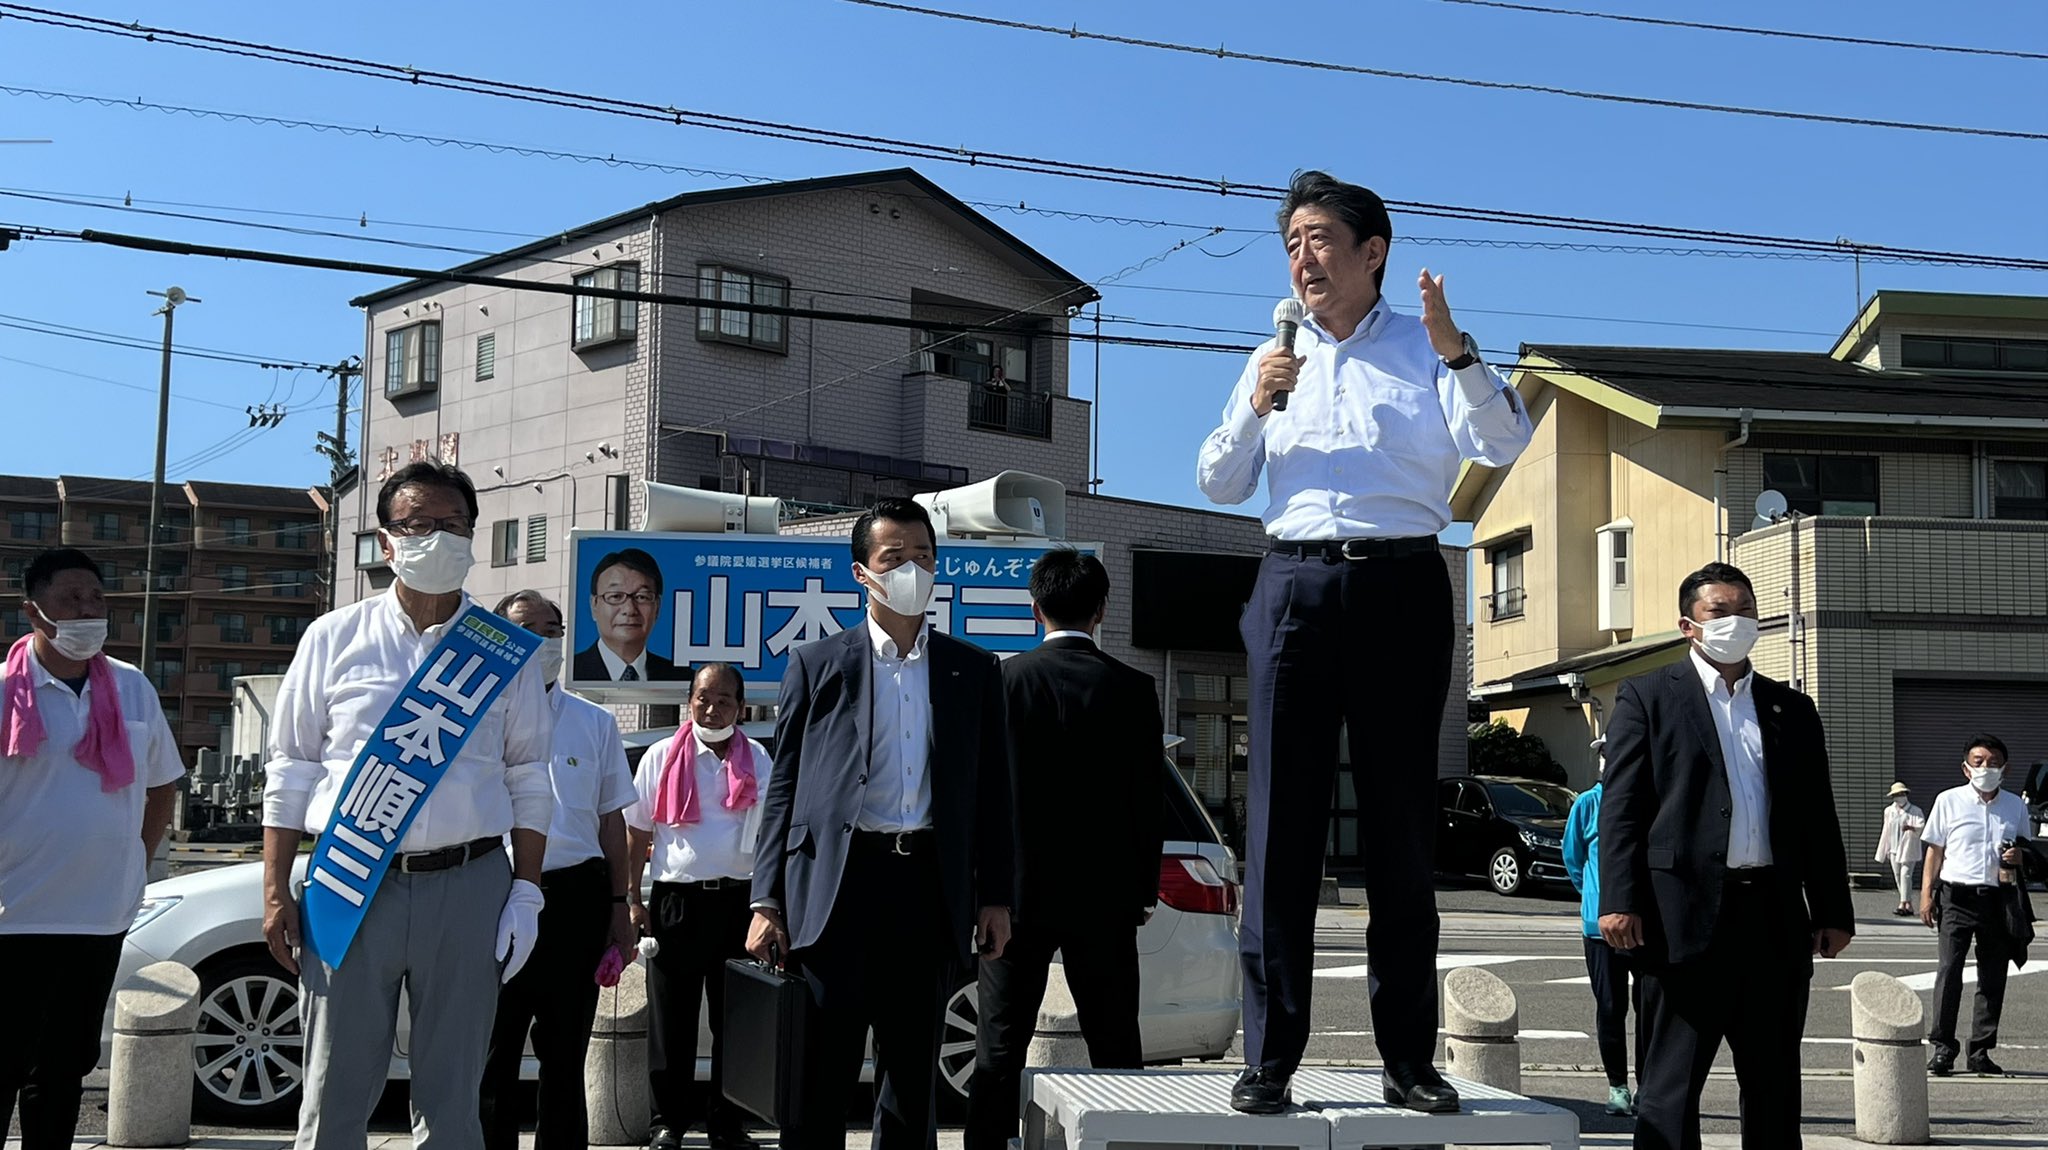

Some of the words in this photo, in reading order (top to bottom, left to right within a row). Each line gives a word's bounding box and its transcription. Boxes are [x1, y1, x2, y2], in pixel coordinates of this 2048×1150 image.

[694, 555, 832, 570] 参議院愛媛選挙区候補者
[674, 576, 1037, 668] 山本三
[312, 647, 500, 908] 山本順三
